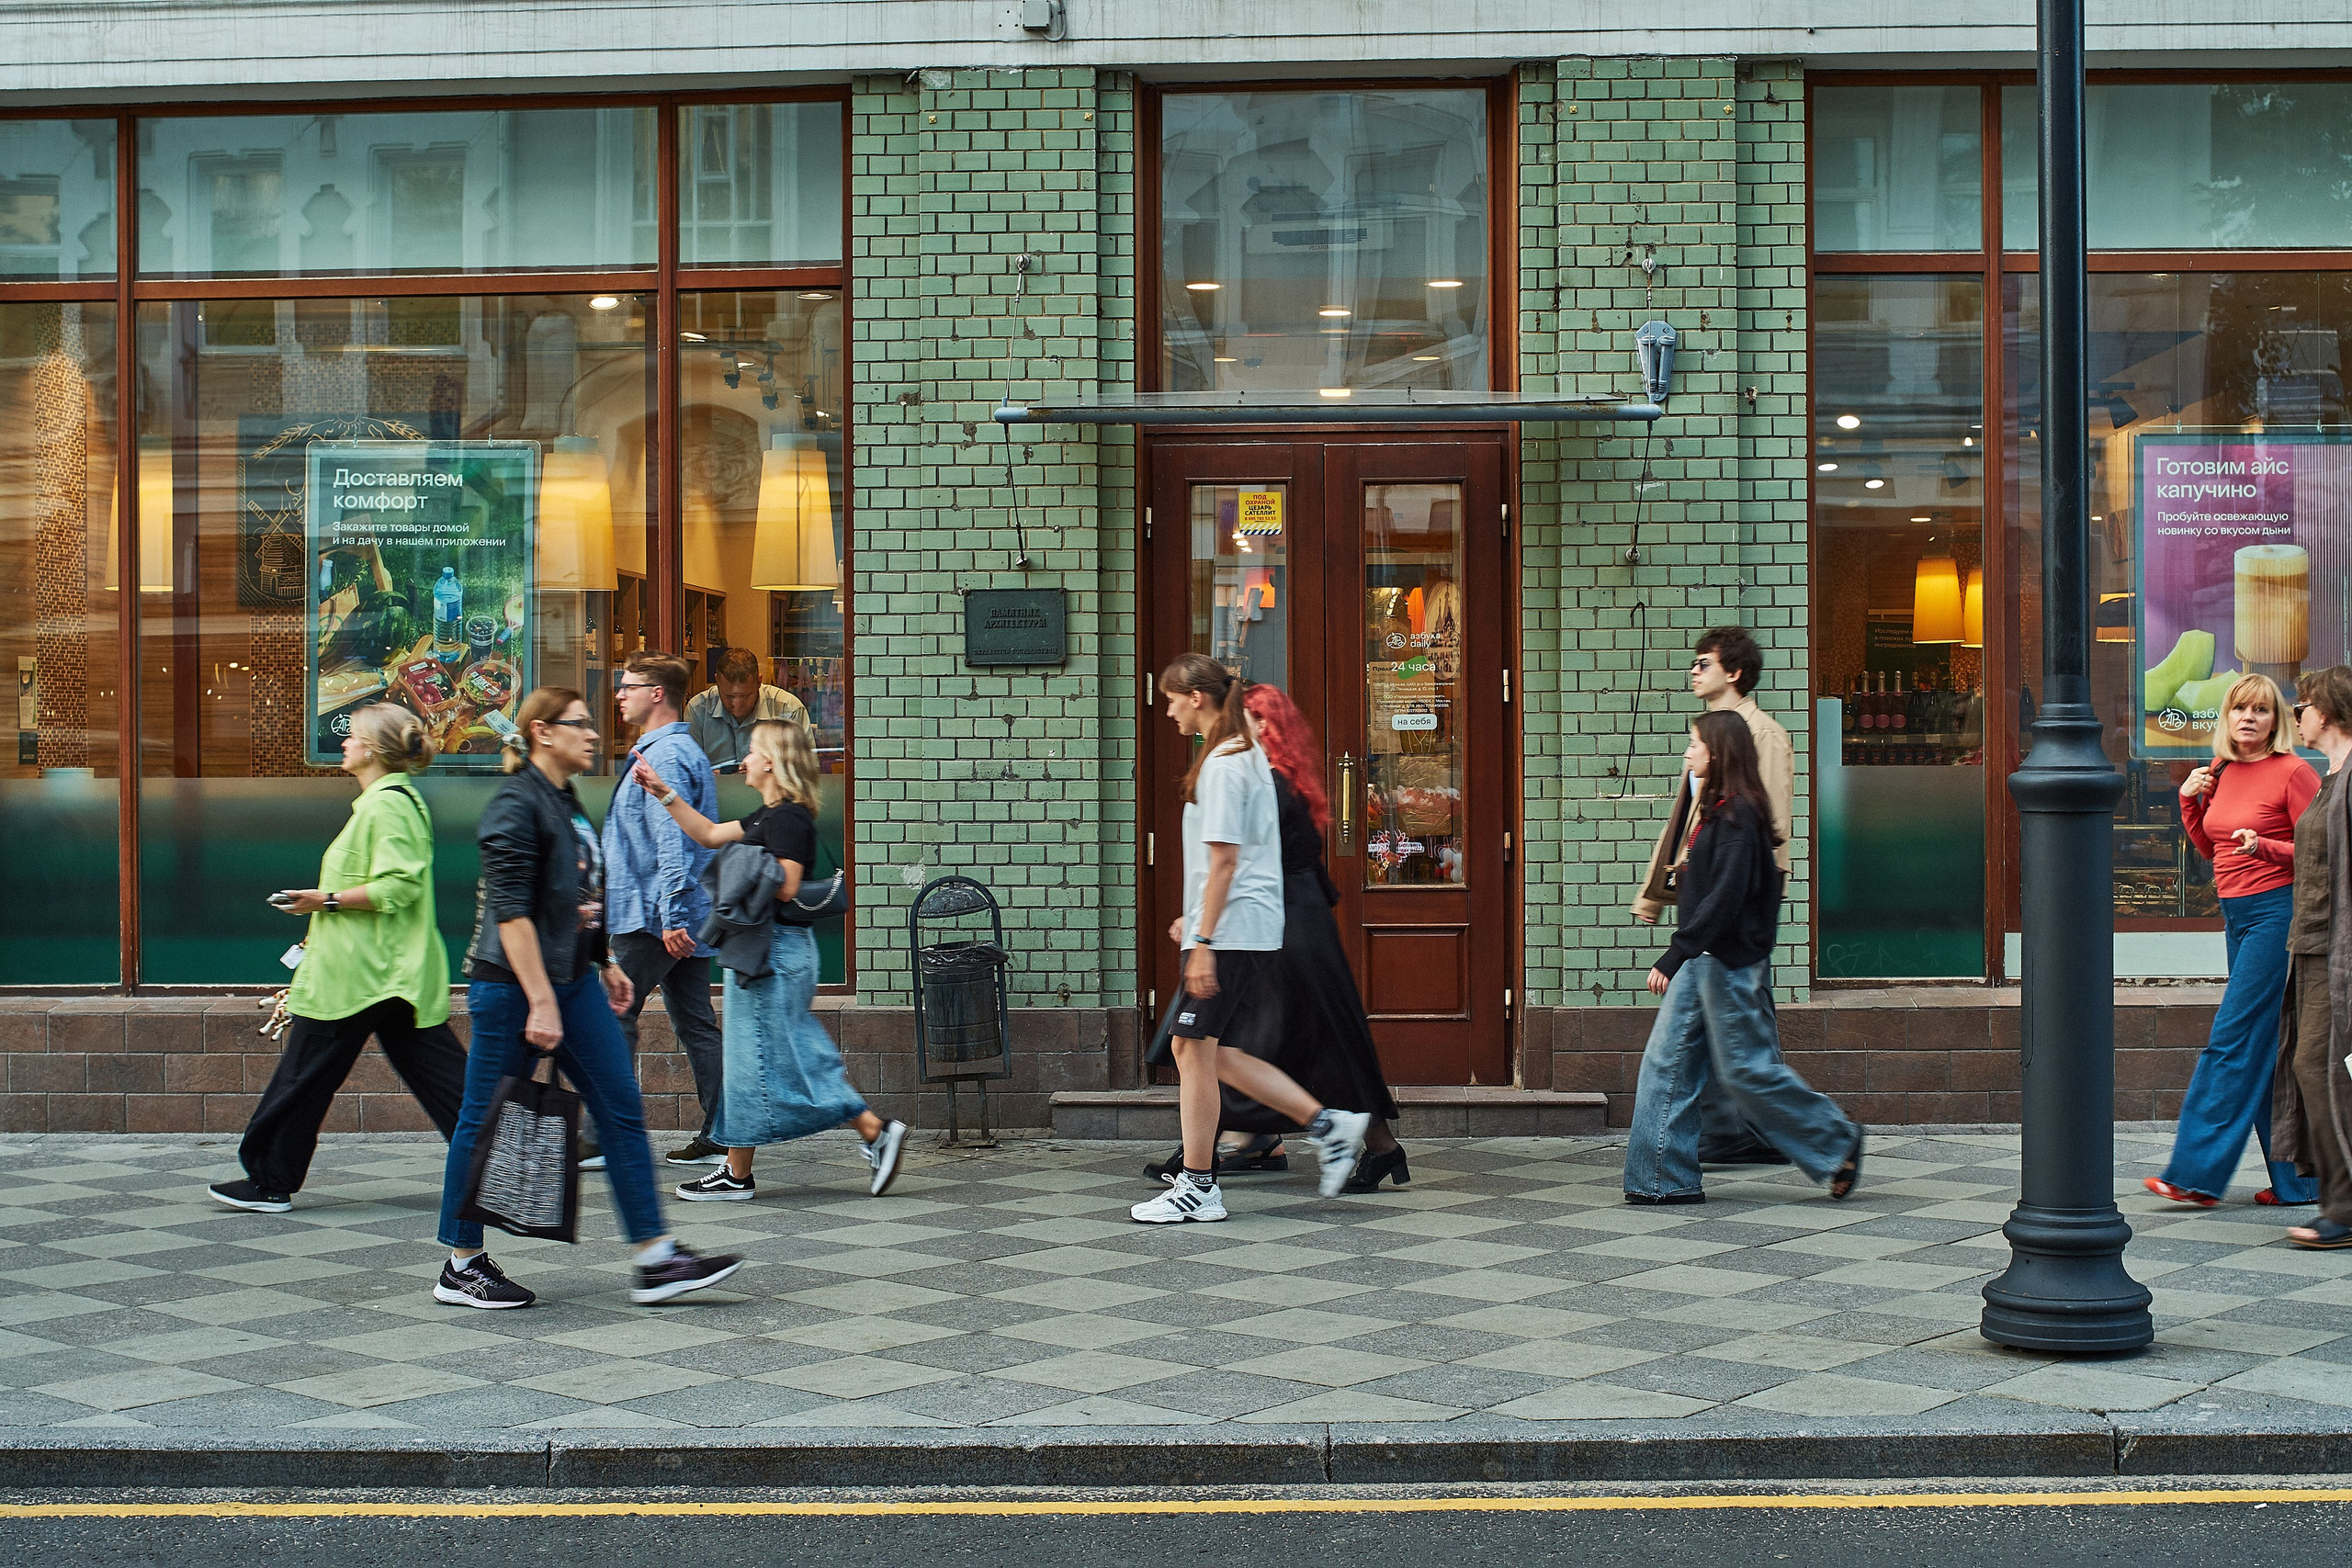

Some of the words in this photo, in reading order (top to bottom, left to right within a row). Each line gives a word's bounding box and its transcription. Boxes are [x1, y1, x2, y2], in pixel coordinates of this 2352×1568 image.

[2156, 457, 2245, 475] Готовим
[2250, 457, 2290, 475] айс
[333, 468, 464, 489] Доставляем
[2156, 484, 2257, 502] капучино
[333, 491, 429, 513] комфорт
[2157, 511, 2211, 524] Пробуйте
[2213, 513, 2290, 524] освежающую
[332, 522, 388, 532] Закажите
[390, 524, 431, 534] товары
[432, 523, 469, 534] домой
[2157, 526, 2202, 536] новинку
[2204, 526, 2219, 536] со
[2220, 526, 2260, 536] вкусом
[2261, 526, 2291, 536] дыни
[342, 537, 356, 546] на
[357, 537, 385, 547] дачу
[386, 537, 393, 546] в
[395, 537, 434, 546] нашем
[435, 537, 506, 548] приложении
[989, 608, 1041, 617] ПАМЯТНИК
[983, 618, 1047, 628] АРХИТЕКТУРЫ
[1409, 631, 1441, 641] азбука
[1409, 639, 1431, 649] daily
[1390, 661, 1406, 671] 24
[1408, 663, 1436, 671] часа
[2192, 707, 2220, 721] азбу
[1409, 717, 1431, 726] себя
